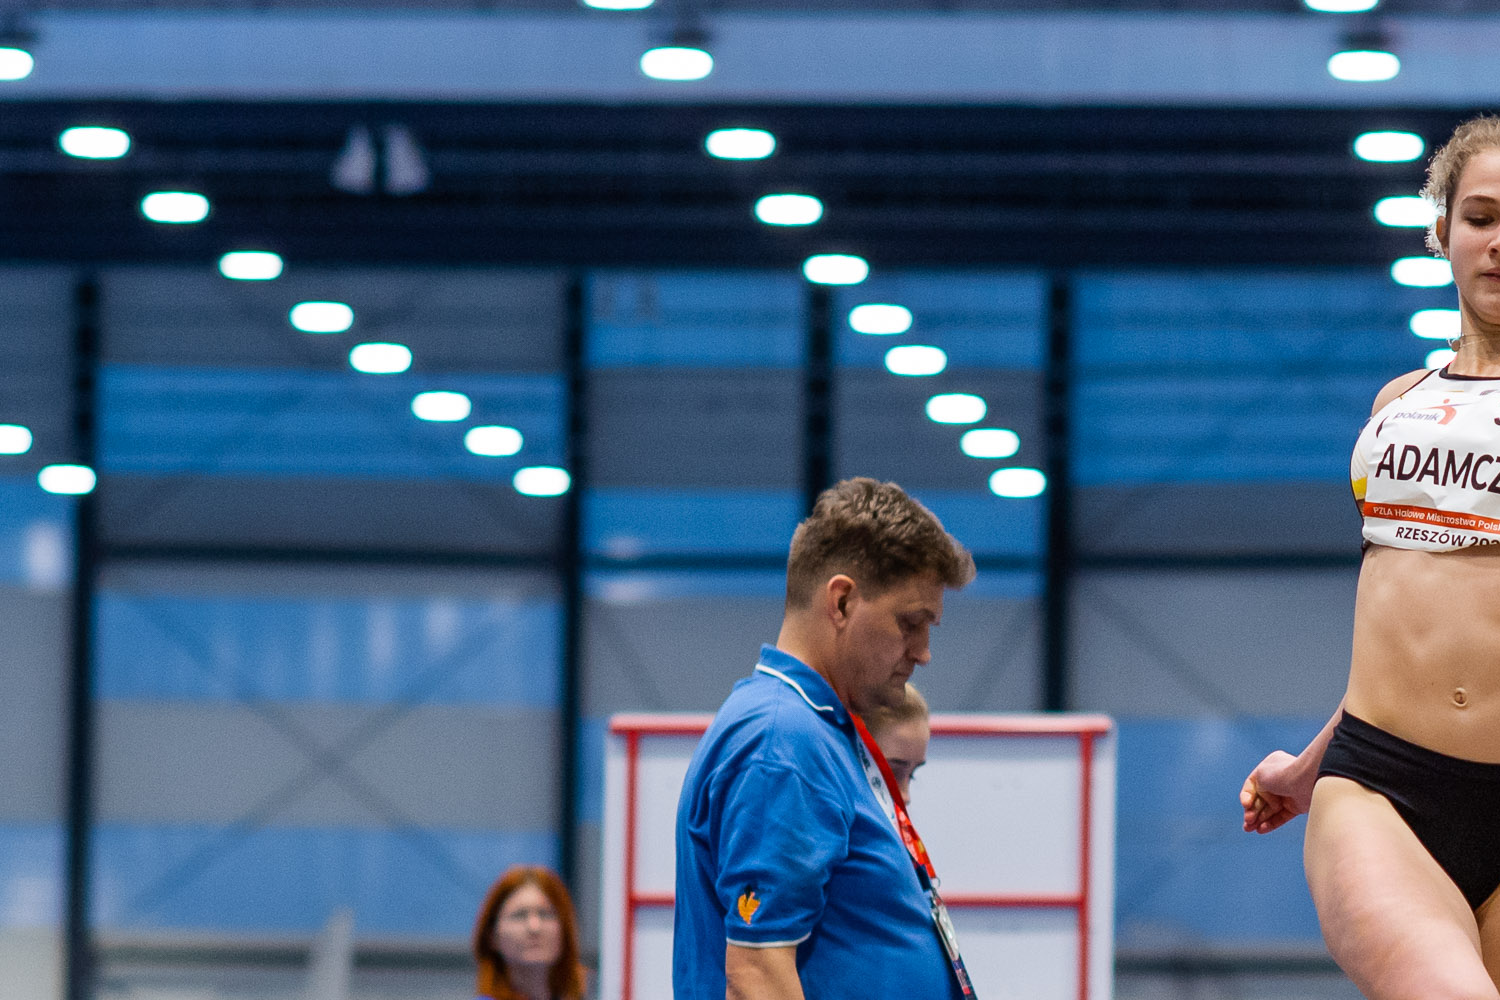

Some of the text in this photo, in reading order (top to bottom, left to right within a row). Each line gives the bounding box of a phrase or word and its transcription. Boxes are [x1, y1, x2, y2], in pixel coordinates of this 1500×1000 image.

[1393, 411, 1440, 421] polanik
[1373, 506, 1393, 516] PZLA
[1395, 508, 1425, 520] Halowe
[1427, 512, 1475, 527] Mistrzostwa
[1396, 526, 1466, 547] RZESZÓW
